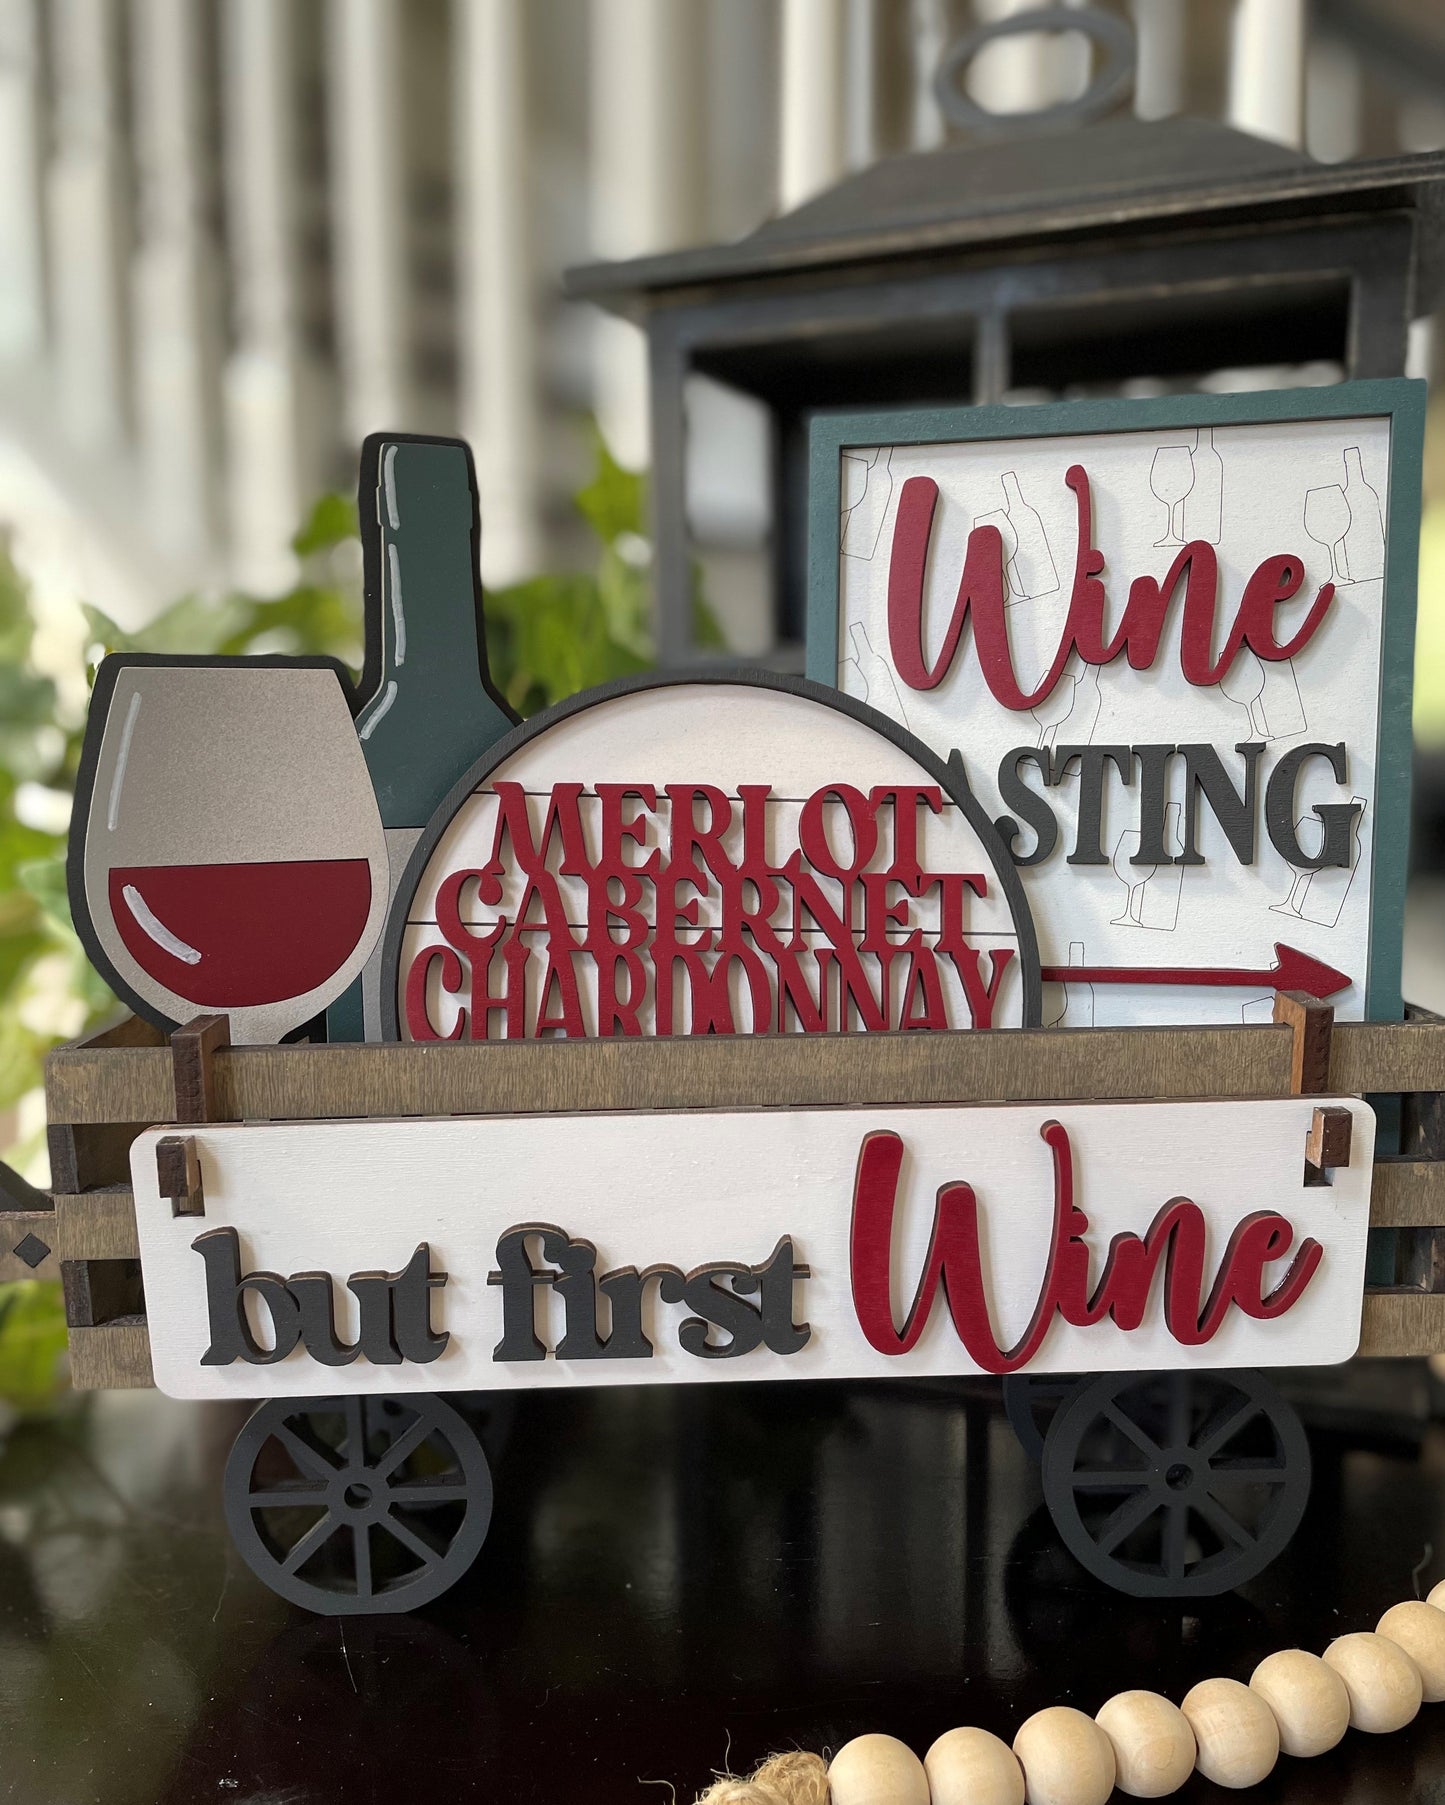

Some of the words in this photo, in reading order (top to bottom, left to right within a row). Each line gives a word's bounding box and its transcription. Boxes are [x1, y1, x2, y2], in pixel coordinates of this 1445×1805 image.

[887, 464, 1335, 711] Wine
[484, 781, 942, 877] MERLOT
[944, 742, 1362, 869] STING
[434, 866, 988, 955] CABERNET
[405, 944, 1015, 1041] CHARDONNAY
[191, 1226, 450, 1366] but
[487, 1221, 812, 1363] first
[849, 1119, 1324, 1374] Wine
